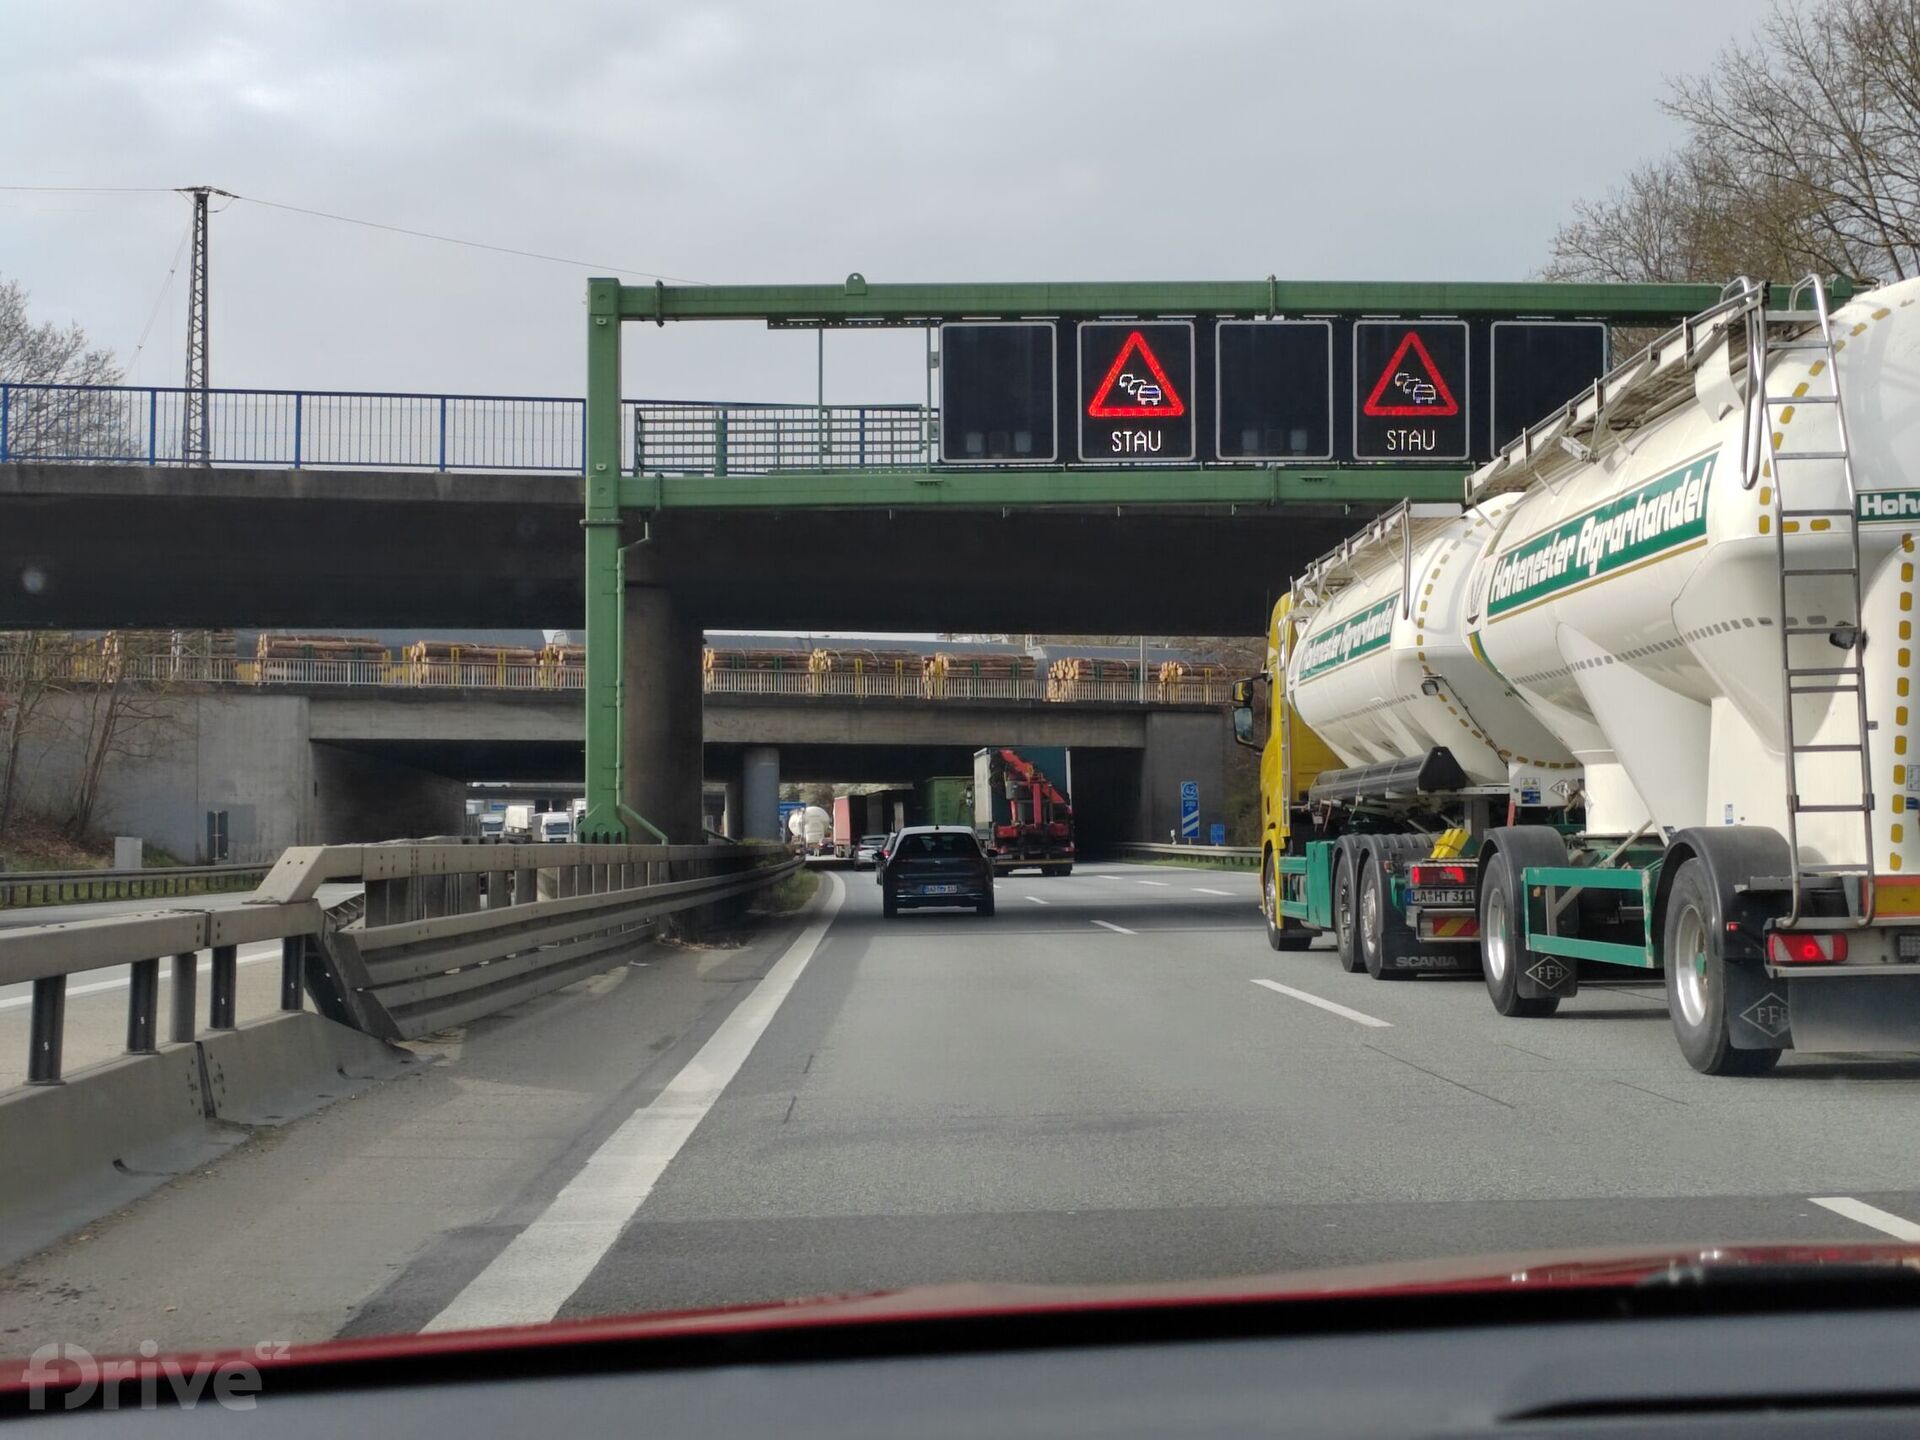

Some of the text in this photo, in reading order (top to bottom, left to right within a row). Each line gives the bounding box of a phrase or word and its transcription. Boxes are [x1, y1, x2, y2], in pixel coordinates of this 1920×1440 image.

[1111, 430, 1161, 452] STAU
[1387, 429, 1435, 451] STAU
[1860, 493, 1920, 516] Hoh
[1489, 461, 1712, 603] Hohenester Agrarhandel
[1339, 597, 1398, 662] Agrarhandel
[1434, 890, 1450, 902] HT
[1452, 890, 1474, 902] 311
[1395, 955, 1459, 968] SCANIA
[1537, 965, 1563, 980] FFB
